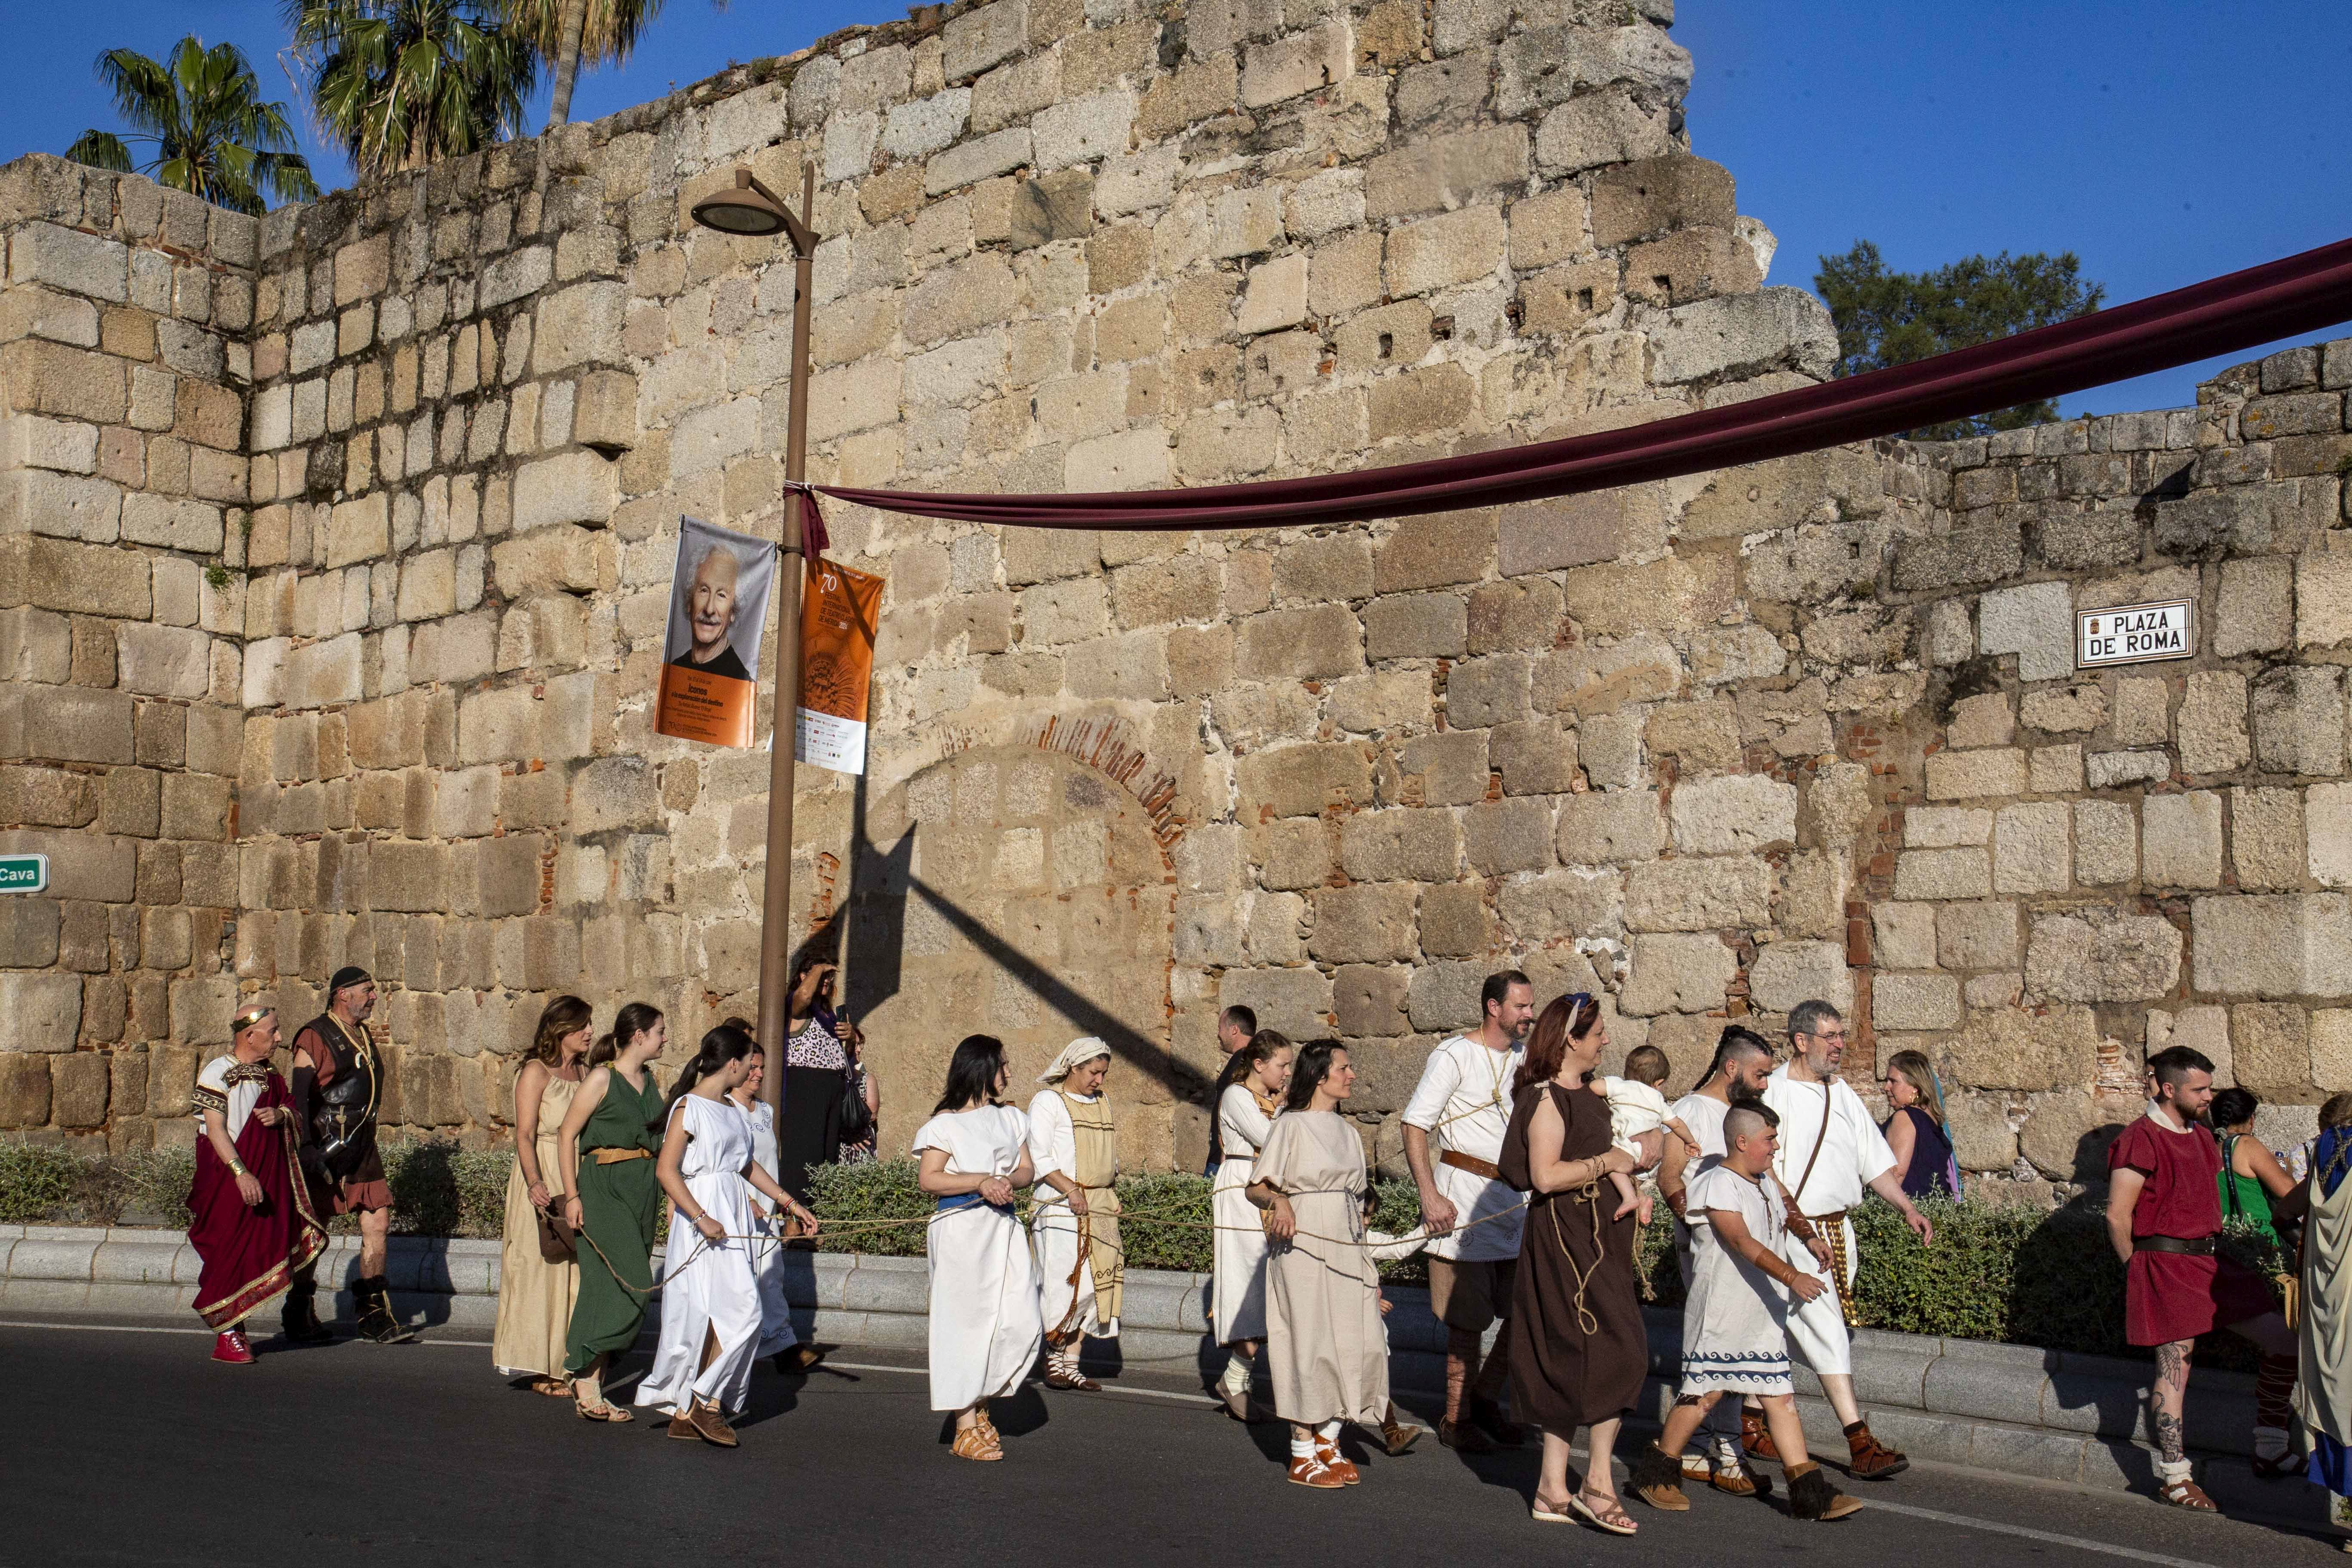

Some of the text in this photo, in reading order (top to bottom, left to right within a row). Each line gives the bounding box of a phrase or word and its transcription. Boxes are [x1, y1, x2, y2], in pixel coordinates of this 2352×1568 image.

[821, 573, 837, 594] 70
[839, 622, 848, 630] 2024
[2114, 611, 2168, 634] PLAZA
[2090, 631, 2181, 656] DE ROMA
[0, 867, 35, 881] Cava
